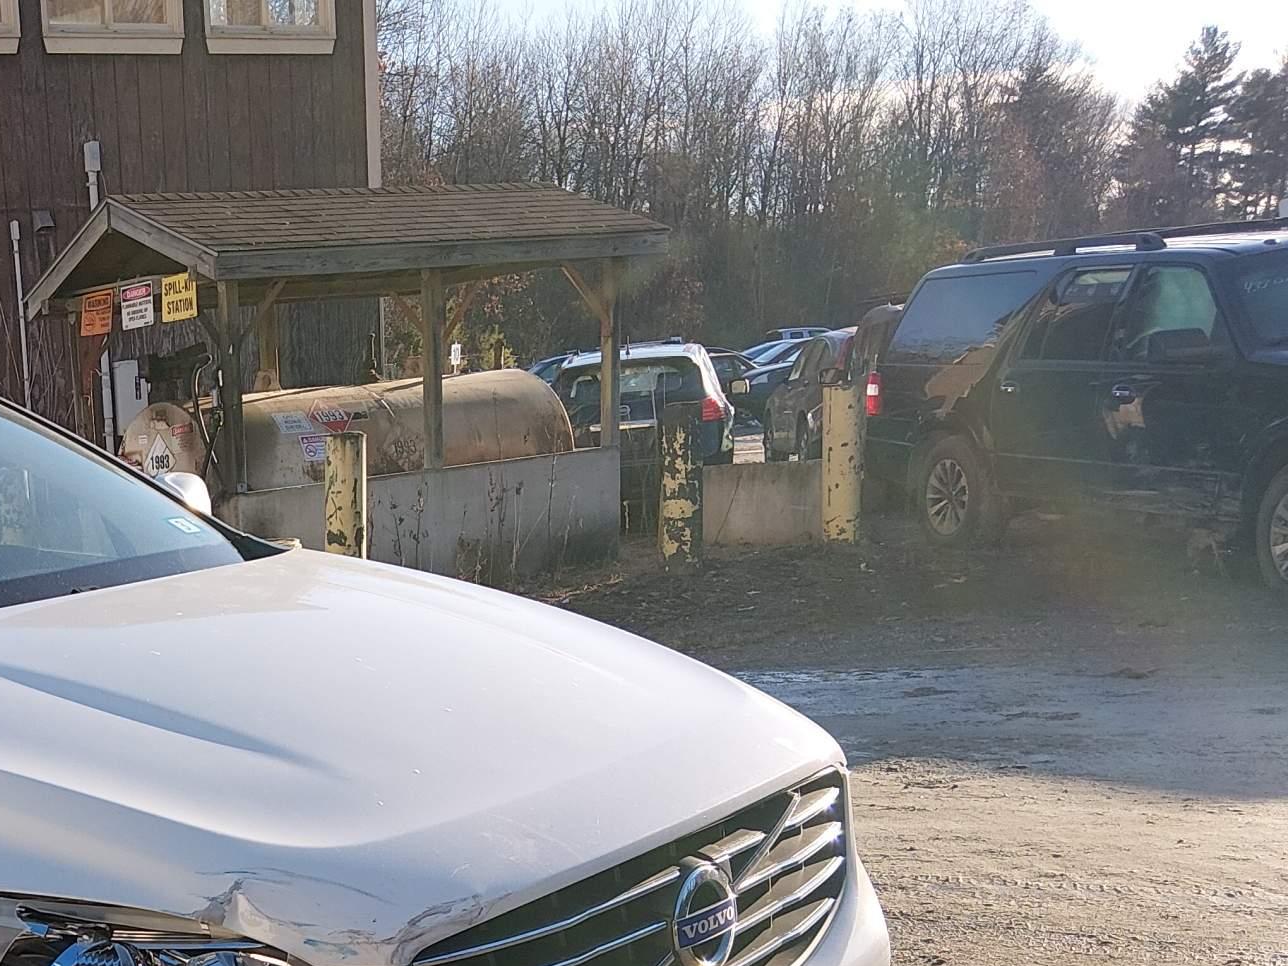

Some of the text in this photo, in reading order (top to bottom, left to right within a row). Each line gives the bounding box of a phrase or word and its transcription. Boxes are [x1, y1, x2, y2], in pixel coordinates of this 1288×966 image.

[126, 287, 146, 299] DANGER
[167, 297, 194, 315] STATION
[316, 409, 345, 422] 1993
[393, 439, 417, 455] 1993
[150, 454, 170, 470] 1993
[681, 905, 734, 939] VOLVO
